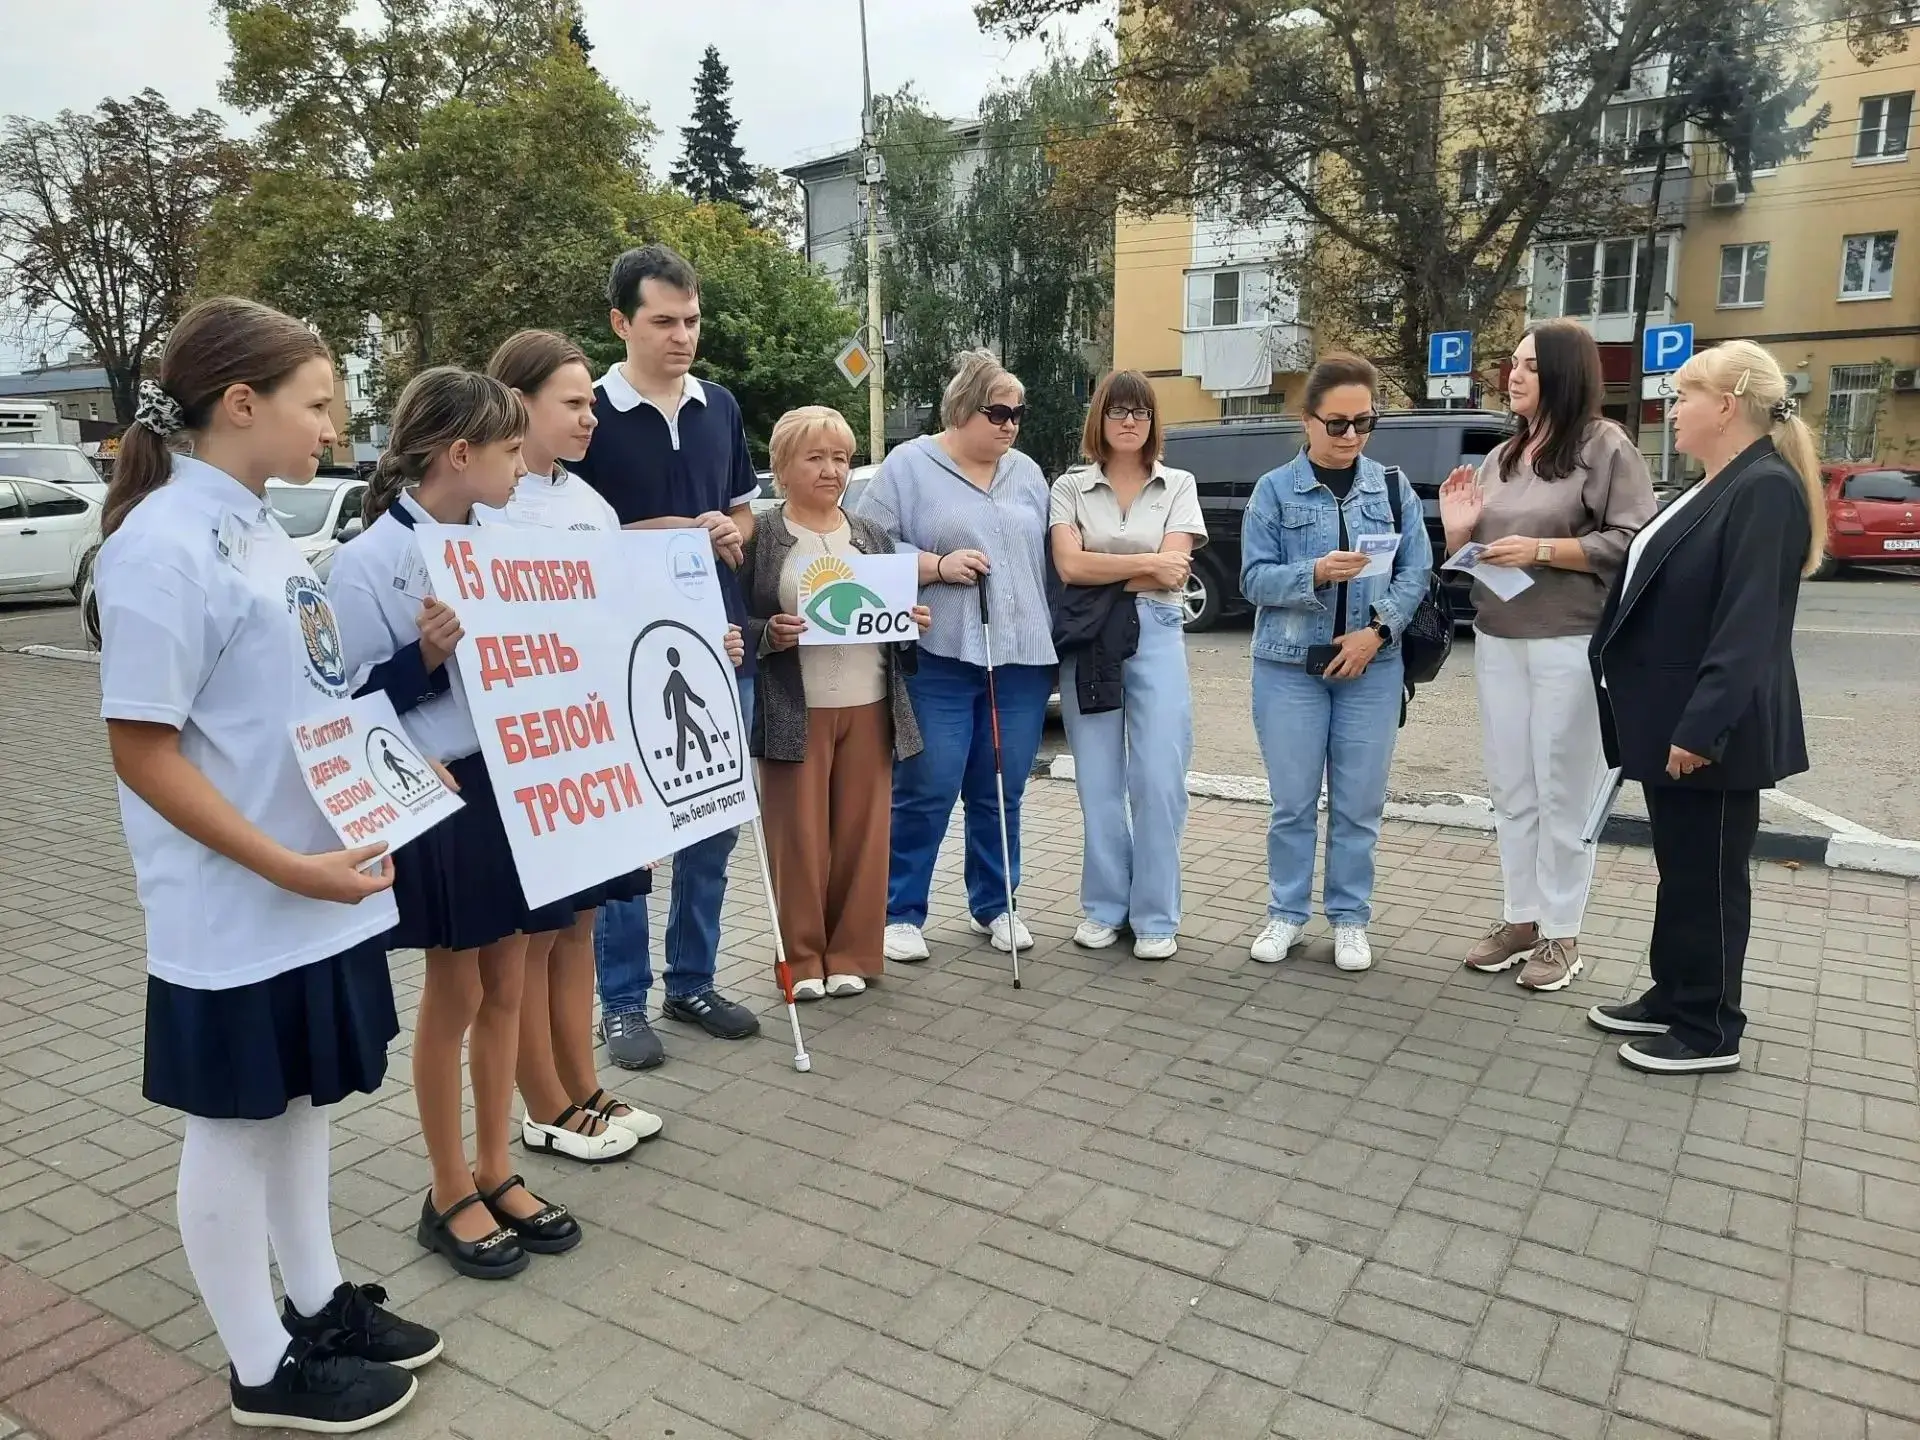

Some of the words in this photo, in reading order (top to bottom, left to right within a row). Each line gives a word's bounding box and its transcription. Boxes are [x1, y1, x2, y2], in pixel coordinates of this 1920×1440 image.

[1441, 337, 1463, 370] P
[1657, 332, 1683, 366] P
[444, 540, 485, 600] 15
[491, 558, 596, 602] ОКТЯБРЯ
[857, 611, 910, 635] ВОС
[475, 633, 579, 691] ДЕНЬ
[296, 725, 312, 752] 15
[312, 716, 353, 748] ОКТЯБРЯ
[495, 692, 614, 764] БЕЛОЙ
[309, 755, 352, 790] ДЕНЬ
[324, 777, 376, 816] БЕЛОЙ
[514, 763, 643, 836] ТРОСТИ
[670, 811, 690, 832] День
[690, 797, 716, 821] белой
[717, 790, 746, 813] трости
[342, 802, 400, 843] ТРОСТИ
